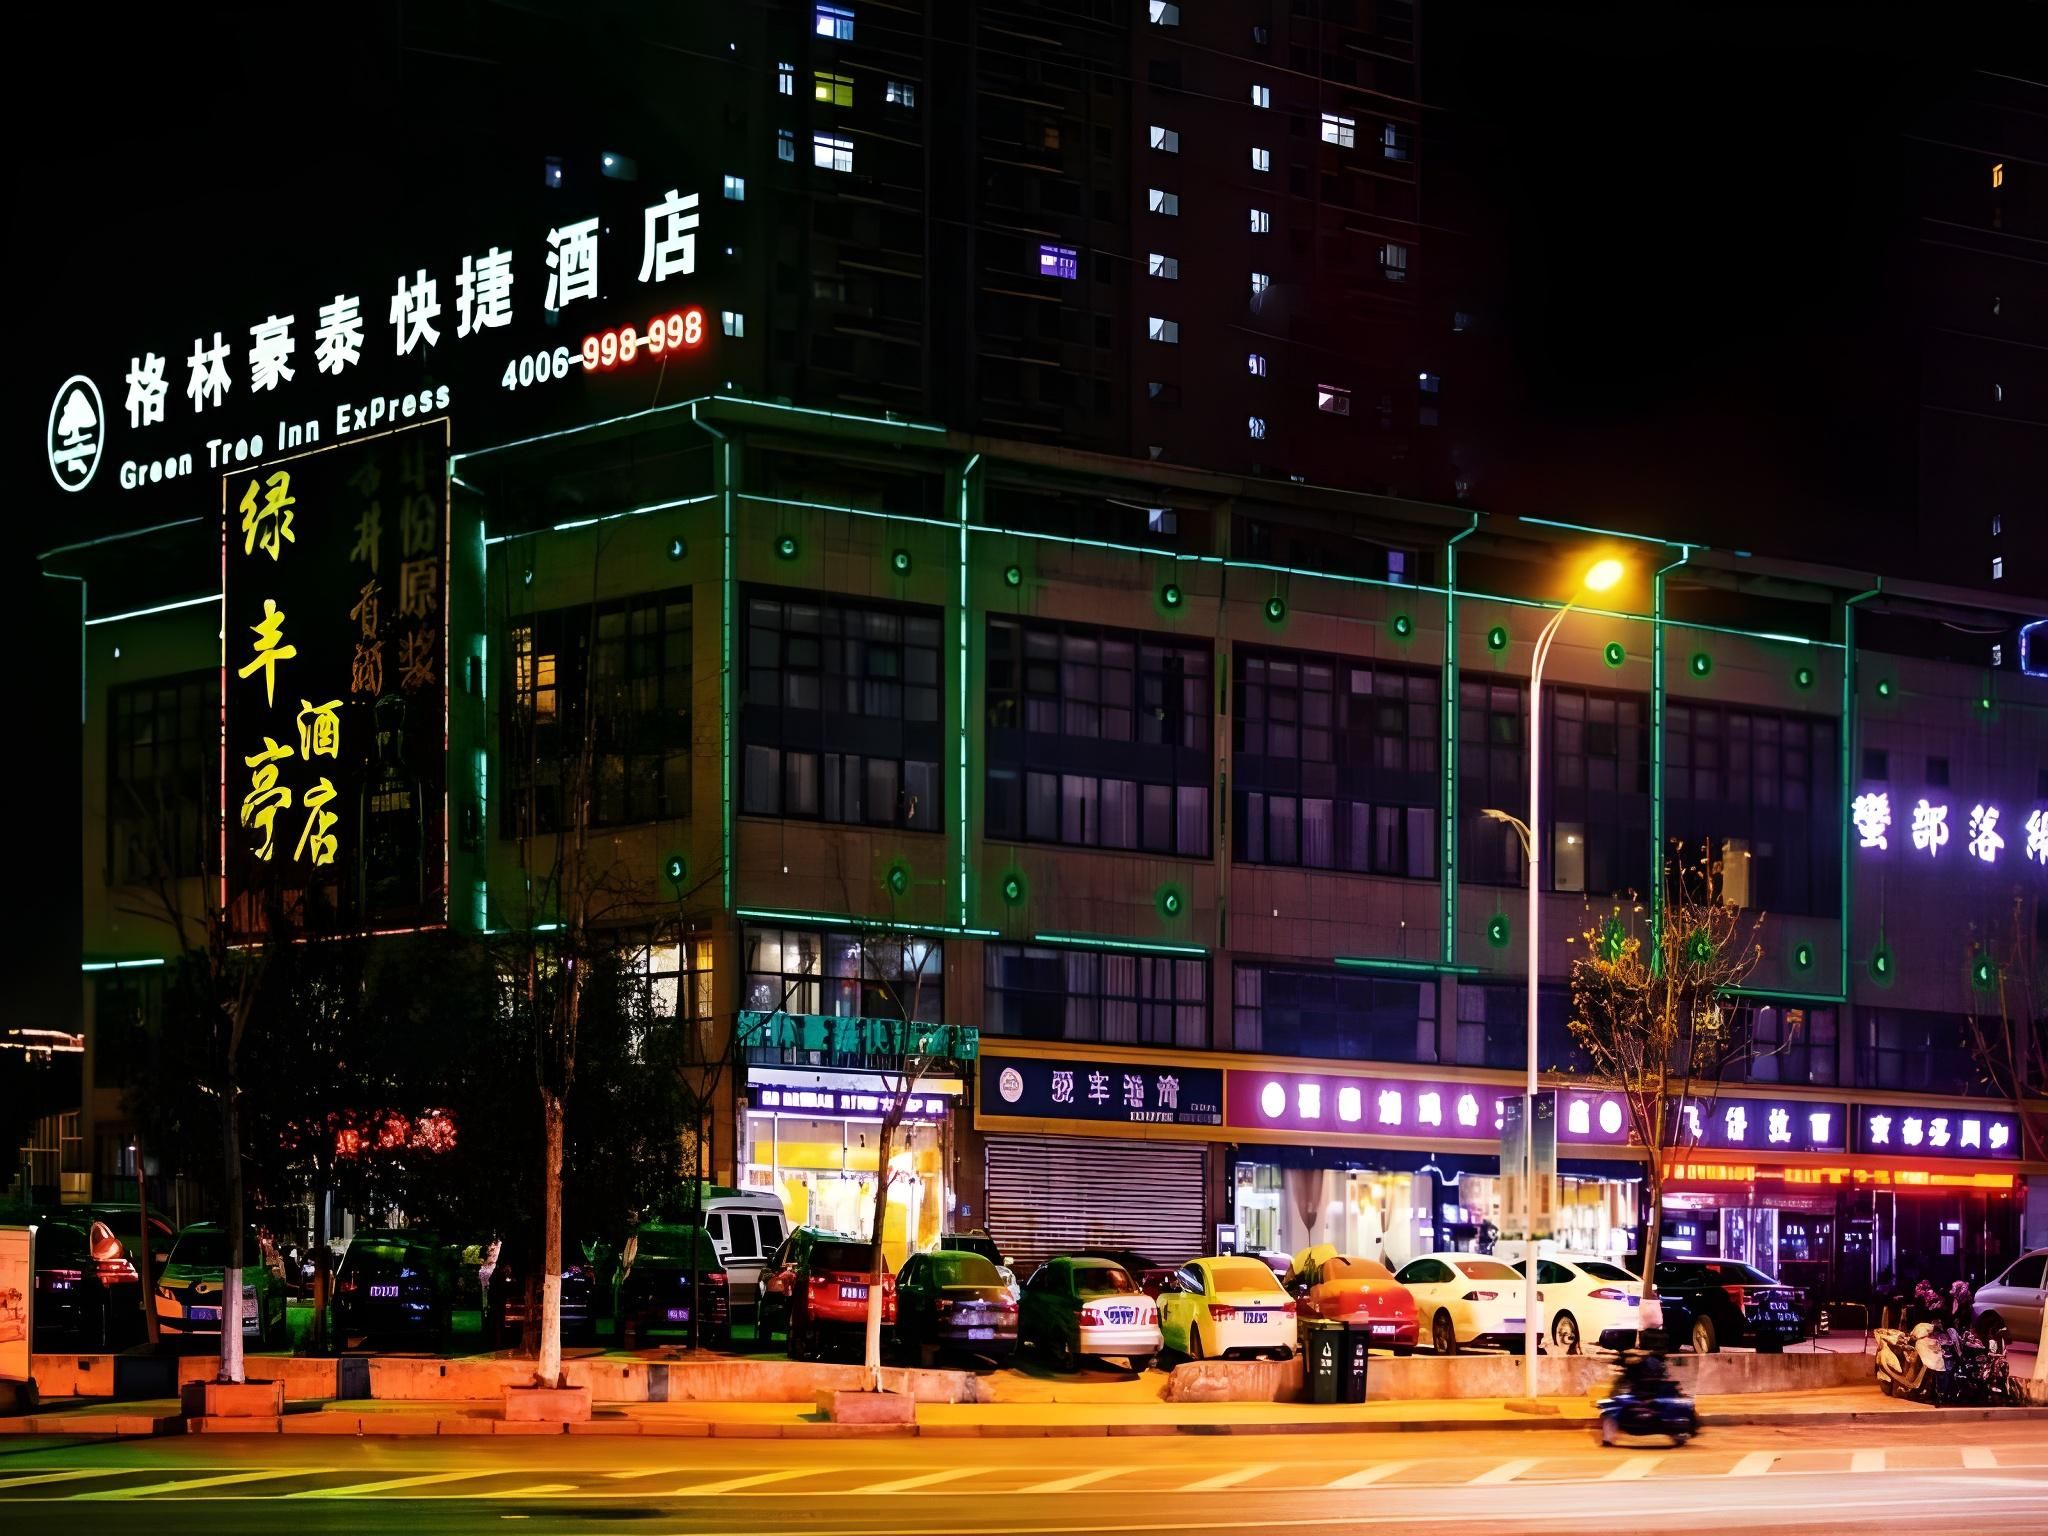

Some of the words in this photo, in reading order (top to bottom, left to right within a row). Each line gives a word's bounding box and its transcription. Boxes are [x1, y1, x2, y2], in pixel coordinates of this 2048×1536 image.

[123, 188, 701, 430] 格林豪泰快捷酒店
[501, 309, 703, 392] 4006-998-998
[278, 420, 321, 451] Inn
[293, 697, 346, 867] 酒店
